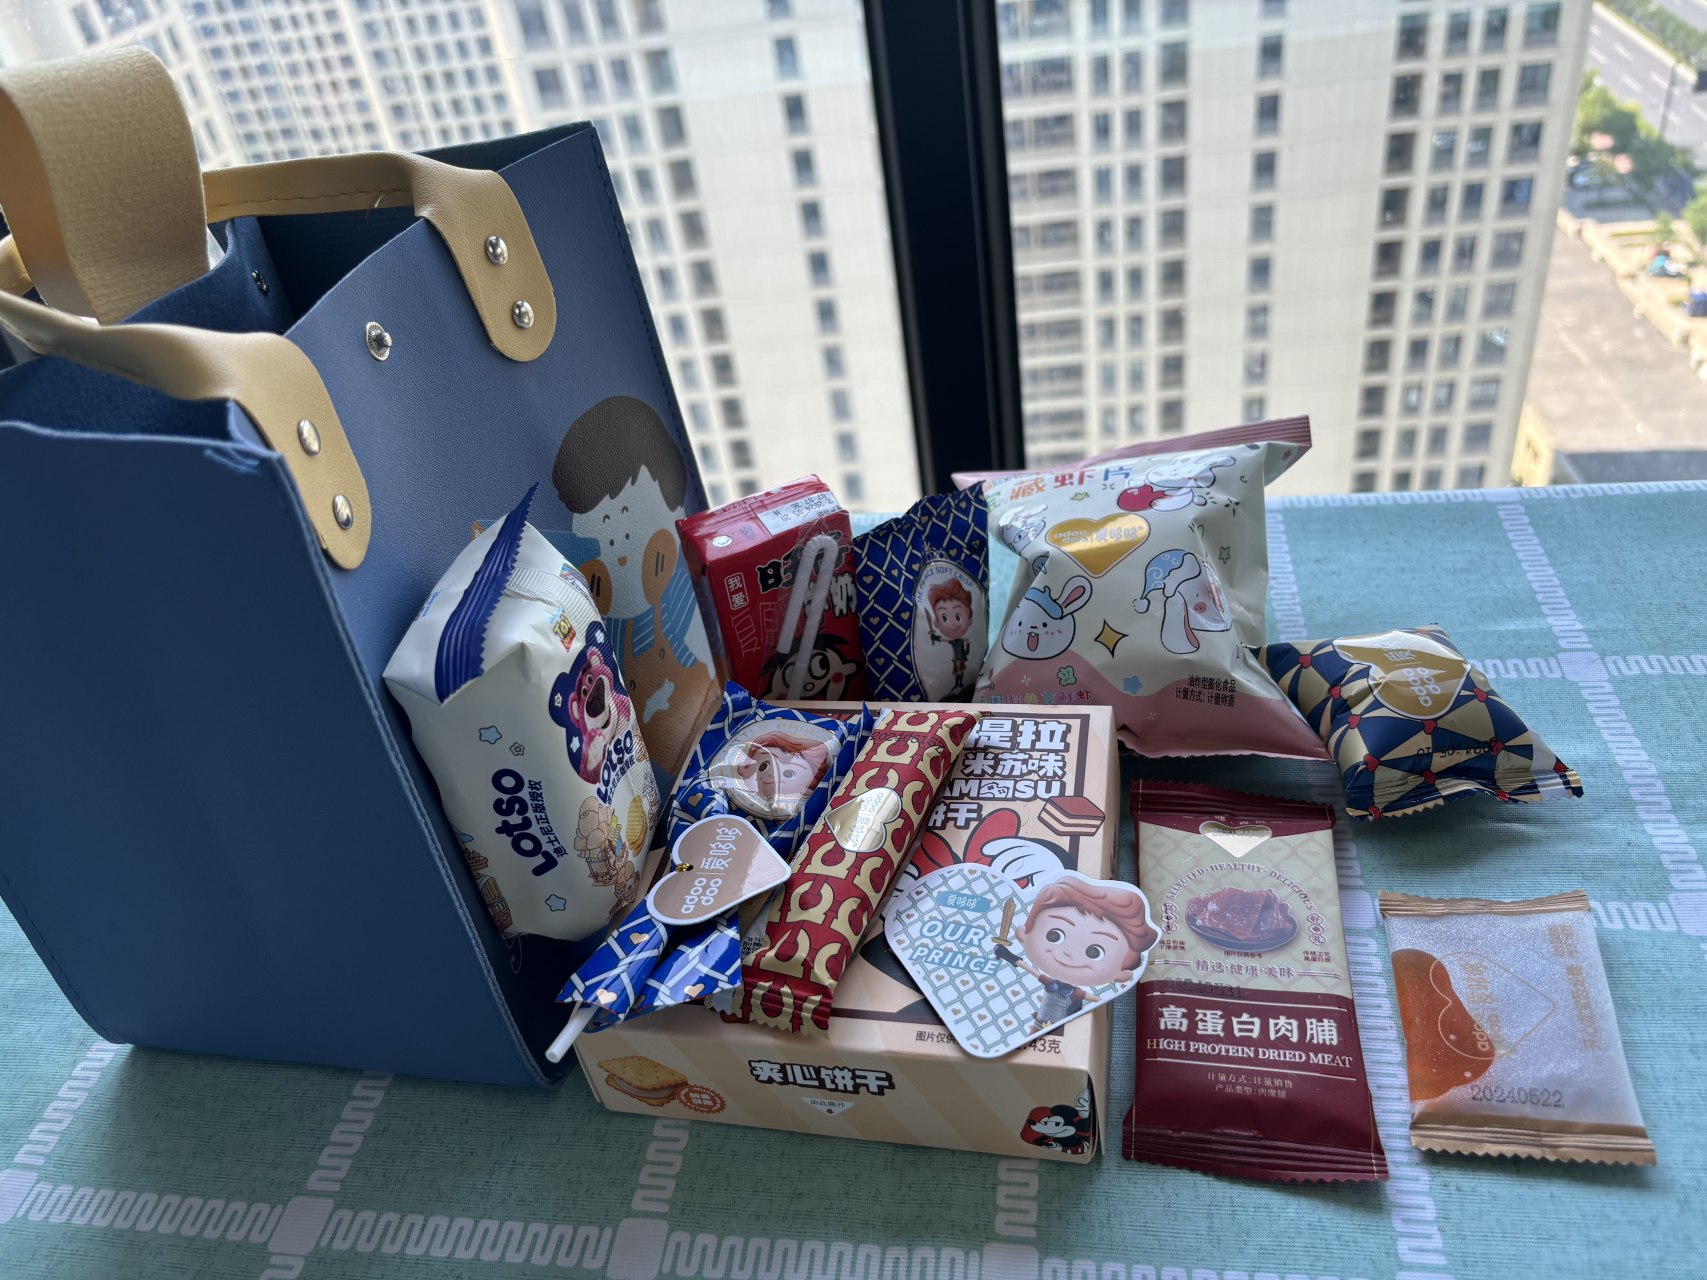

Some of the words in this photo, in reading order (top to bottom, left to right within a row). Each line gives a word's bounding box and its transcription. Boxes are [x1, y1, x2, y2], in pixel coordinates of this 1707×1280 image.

[935, 566, 954, 576] SOFT
[953, 570, 974, 587] CRISP
[727, 575, 747, 608] 我爱
[1187, 675, 1236, 693] 油炸型膨化食品
[1402, 668, 1433, 707] adoo
[1417, 667, 1442, 695] doo
[962, 752, 1064, 776] 米苏味
[527, 779, 569, 858] 迪士尼正版授权
[681, 878, 707, 914] adoo
[700, 878, 723, 906] doo
[922, 920, 985, 945] OUR
[911, 946, 999, 974] PRINCE
[916, 1031, 958, 1045] 图片仅供
[1159, 1005, 1339, 1046] 高蛋白肉脯
[1472, 1013, 1490, 1052] adoo
[1016, 1038, 1061, 1054] .43克
[1146, 1038, 1187, 1052] HIGH
[1188, 1041, 1255, 1058] PROTEIN
[1258, 1051, 1306, 1063] DRIED
[1309, 1053, 1353, 1068] MEAT
[750, 1061, 890, 1093] 夹心饼干
[1470, 1085, 1565, 1108] 20240522
